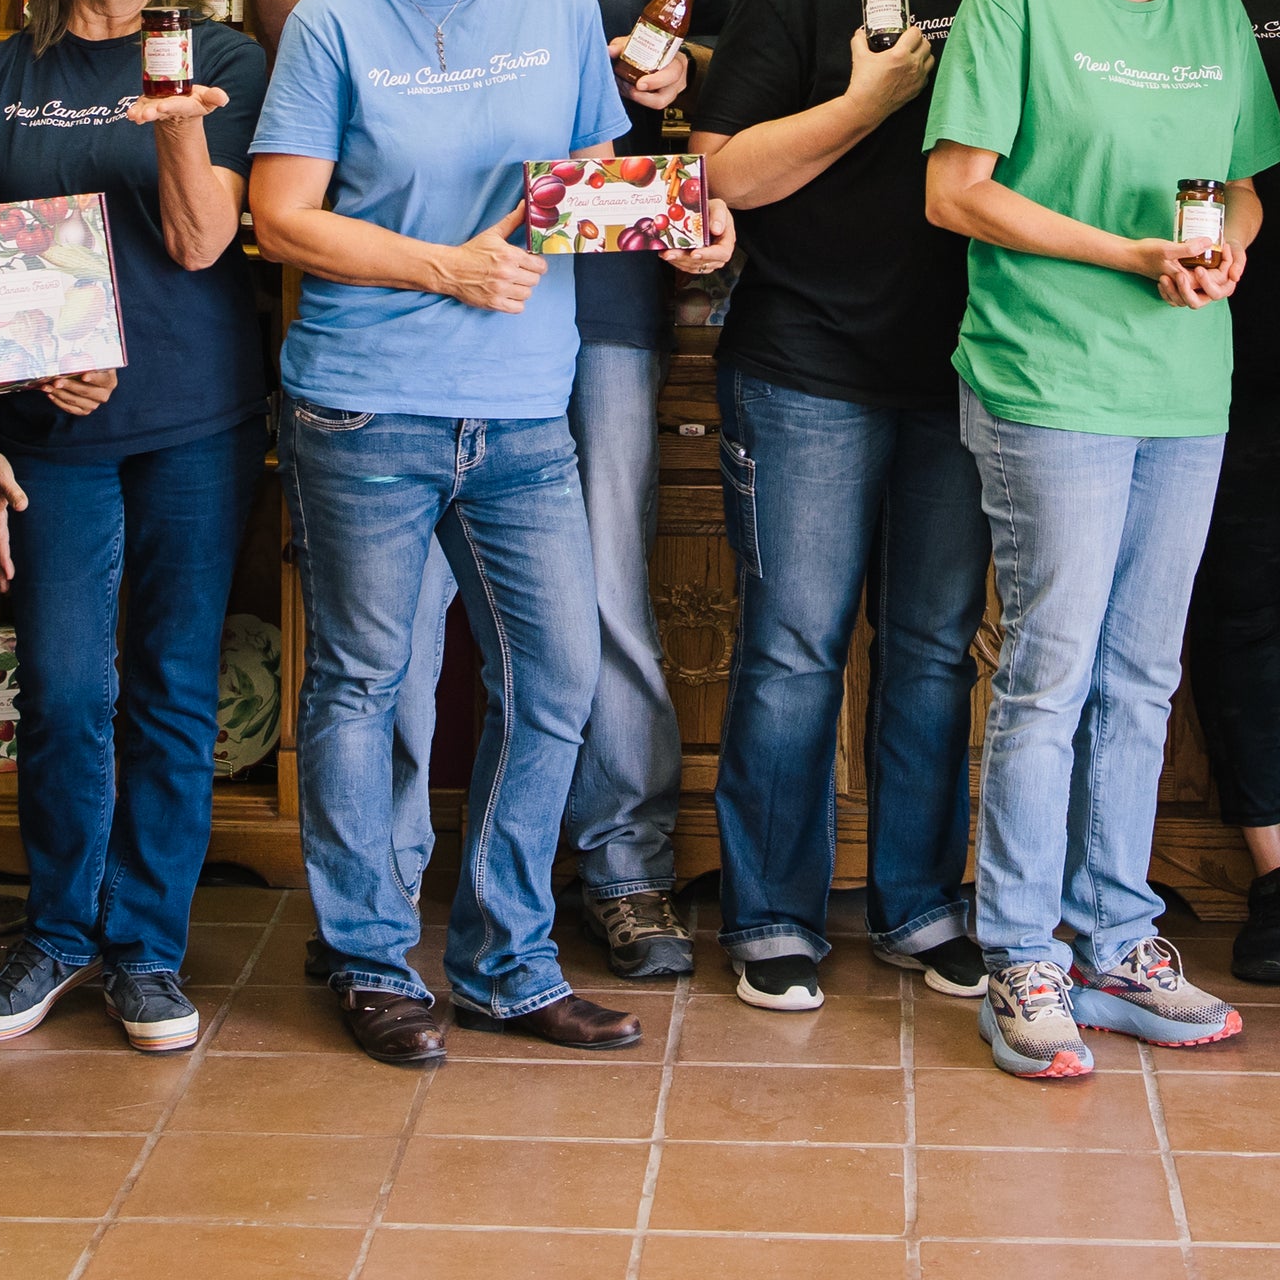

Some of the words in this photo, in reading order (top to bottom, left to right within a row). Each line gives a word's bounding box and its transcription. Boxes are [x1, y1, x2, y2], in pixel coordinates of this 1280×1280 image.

[368, 68, 411, 88] New
[415, 67, 487, 85] Canaan
[489, 49, 551, 75] Farms
[1073, 52, 1111, 71] New
[1114, 60, 1170, 82] Canaan
[1172, 65, 1223, 82] Farms
[407, 82, 470, 96] HANDCRAFTED
[473, 80, 483, 89] IN
[485, 73, 518, 87] UTOPIA
[1108, 75, 1160, 90] HANDCRAFTED
[1171, 82, 1202, 90] UTOPIA
[42, 100, 111, 119] Canaan
[29, 117, 91, 128] HANDCRAFTED
[93, 118, 103, 126] IN
[105, 113, 129, 124] UTOP
[567, 196, 590, 207] New
[592, 195, 630, 207] Canaan
[631, 193, 663, 205] Farms
[0, 286, 32, 296] Canaan
[32, 280, 60, 292] Farms
